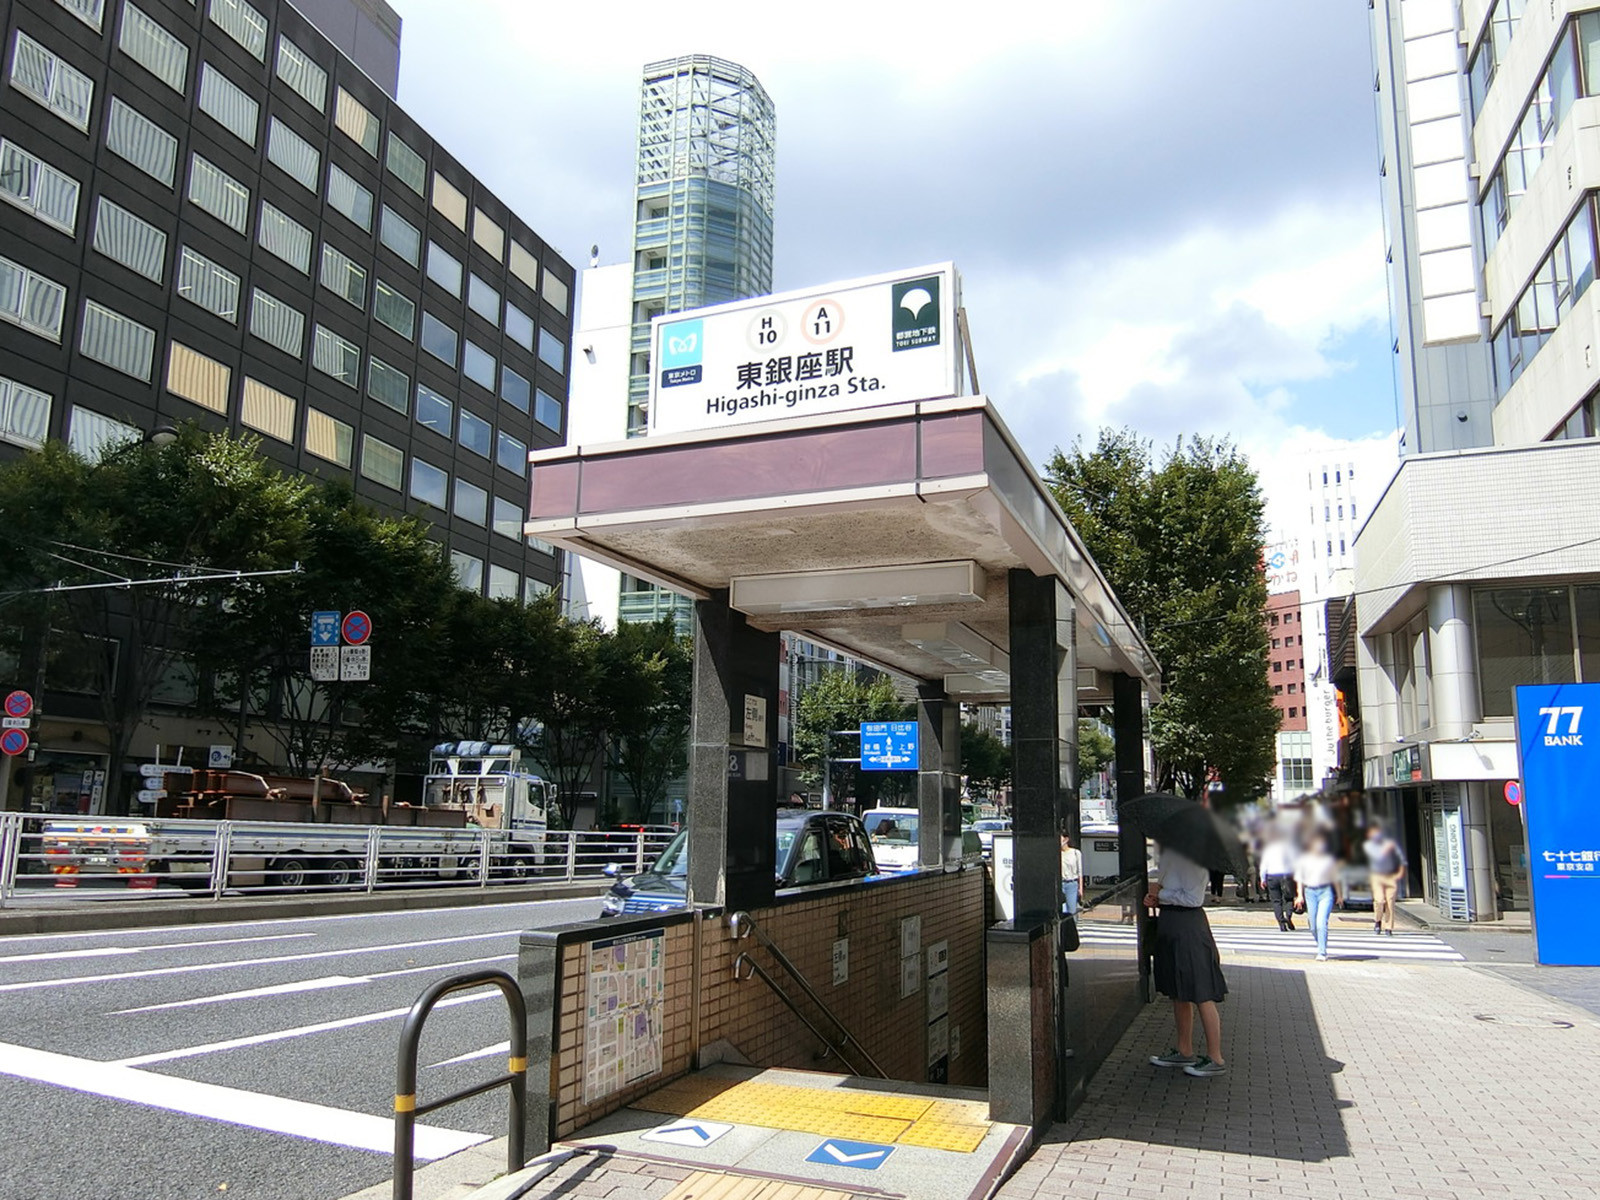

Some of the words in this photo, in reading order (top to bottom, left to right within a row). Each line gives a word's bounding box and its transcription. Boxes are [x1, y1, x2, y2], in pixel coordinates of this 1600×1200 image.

[817, 307, 828, 320] A
[762, 316, 772, 329] H
[814, 321, 830, 335] 11
[759, 330, 777, 345] 10
[911, 335, 936, 345] SUBWAY
[736, 346, 853, 390] 東銀座駅
[706, 382, 839, 416] Higashi-ginza
[847, 376, 886, 394] Sta.
[1538, 706, 1584, 735] 77
[1544, 735, 1584, 746] BANK
[1556, 863, 1594, 872] 東京支店
